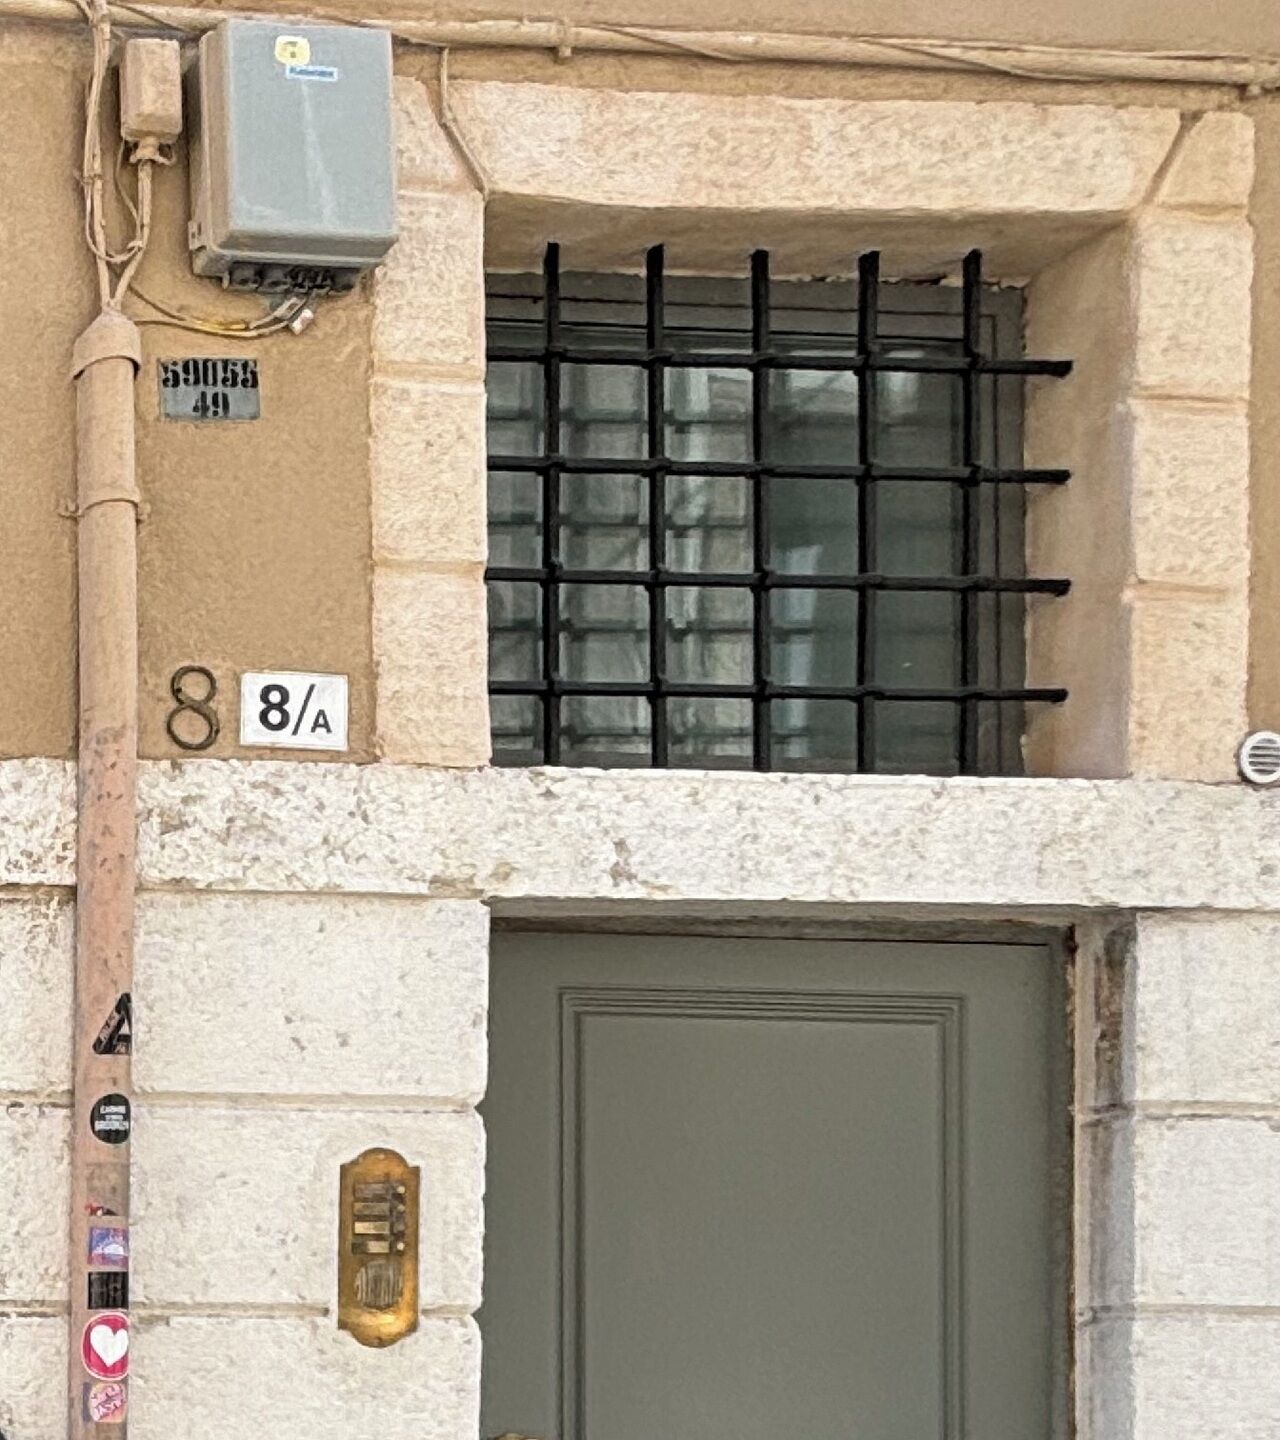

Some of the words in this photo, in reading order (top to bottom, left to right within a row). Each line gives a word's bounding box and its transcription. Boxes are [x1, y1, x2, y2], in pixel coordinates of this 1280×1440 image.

[161, 359, 258, 388] 59055
[192, 391, 230, 417] 49
[167, 665, 220, 750] 8
[259, 683, 332, 736] 8/A
